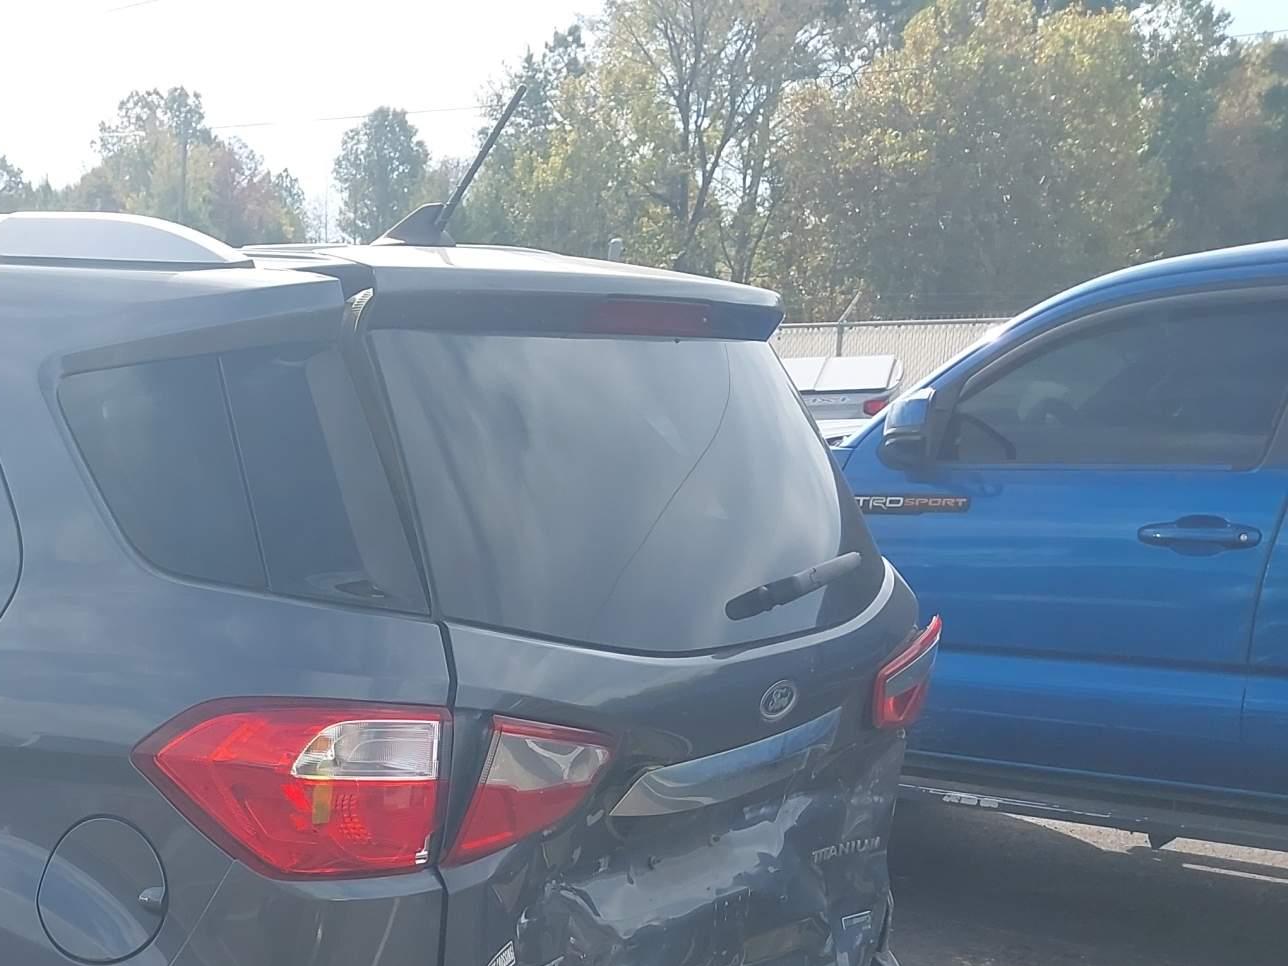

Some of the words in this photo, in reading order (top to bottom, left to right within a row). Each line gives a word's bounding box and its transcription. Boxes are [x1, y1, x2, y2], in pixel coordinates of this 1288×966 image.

[854, 496, 904, 510] TRD
[904, 498, 967, 507] SPORT
[811, 836, 881, 863] TITANIUM
